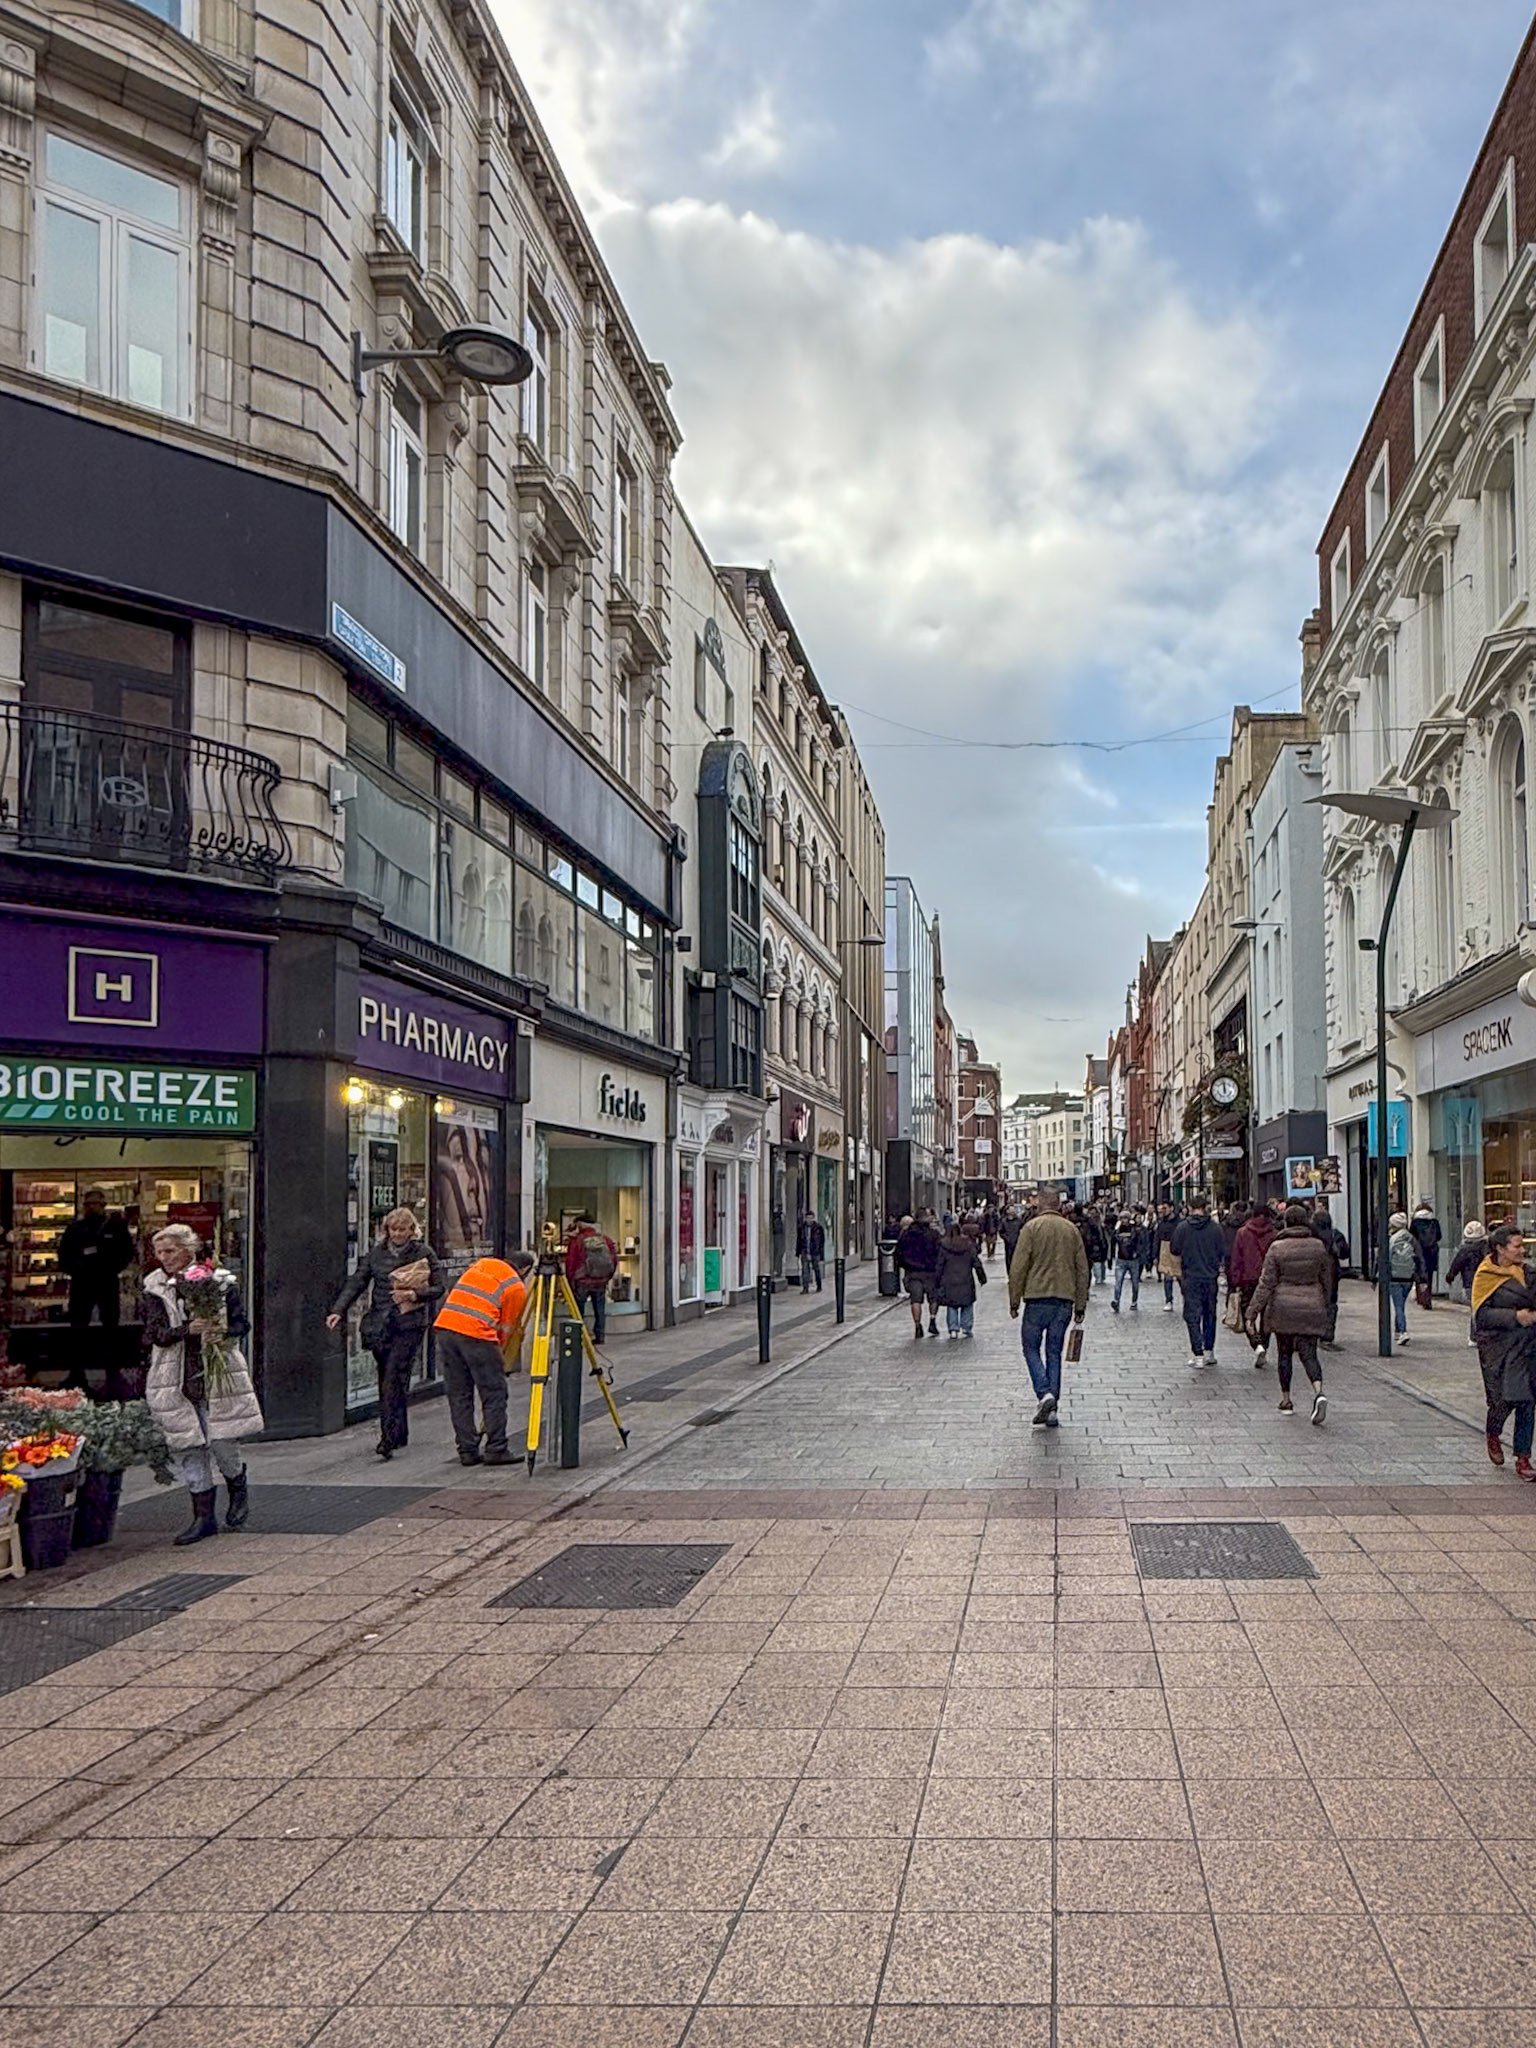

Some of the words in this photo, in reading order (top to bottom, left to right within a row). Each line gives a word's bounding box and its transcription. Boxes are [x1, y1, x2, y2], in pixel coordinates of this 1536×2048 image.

[95, 972, 132, 1002] H
[360, 996, 509, 1074] PHARMACY
[64, 1105, 125, 1121] COOL
[137, 1107, 178, 1123] THE
[189, 1110, 239, 1125] PAIN
[599, 1073, 647, 1122] fields
